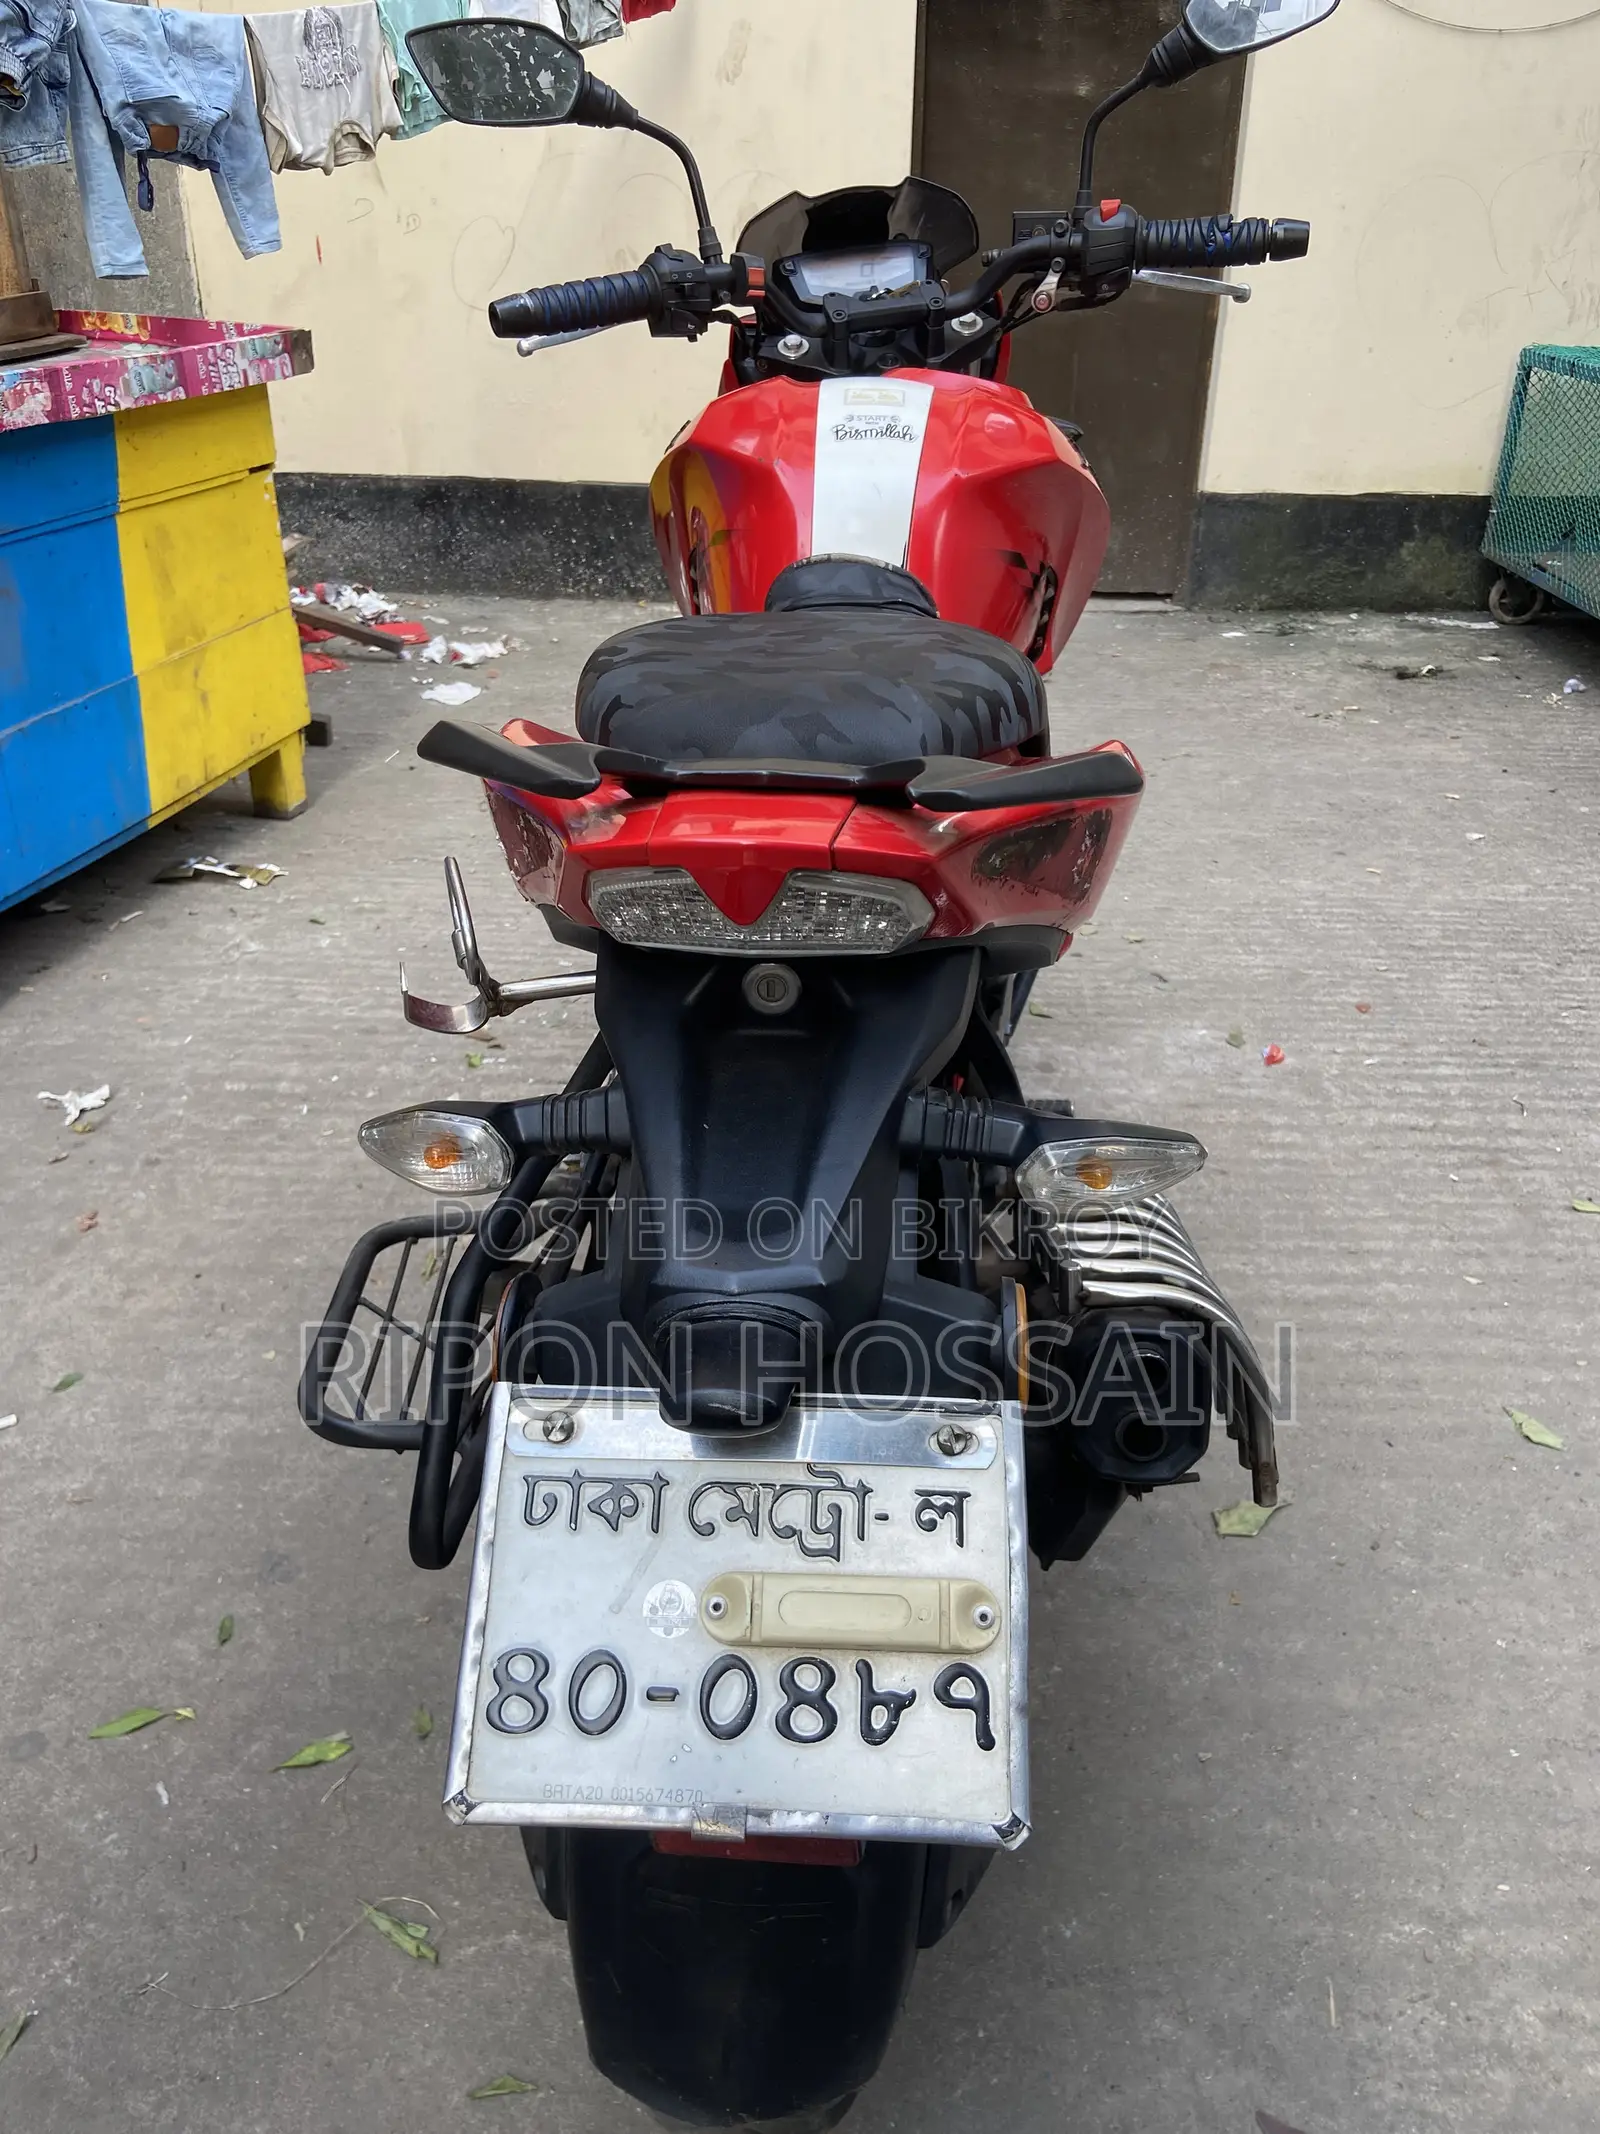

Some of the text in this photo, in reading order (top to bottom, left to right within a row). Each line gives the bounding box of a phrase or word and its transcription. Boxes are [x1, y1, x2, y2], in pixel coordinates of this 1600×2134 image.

[833, 423, 915, 442] Bismillah
[521, 1468, 670, 1534] ঢাকা
[484, 1645, 997, 1752] ৪০-০৪৮৭
[542, 1783, 604, 1801] BRTA20
